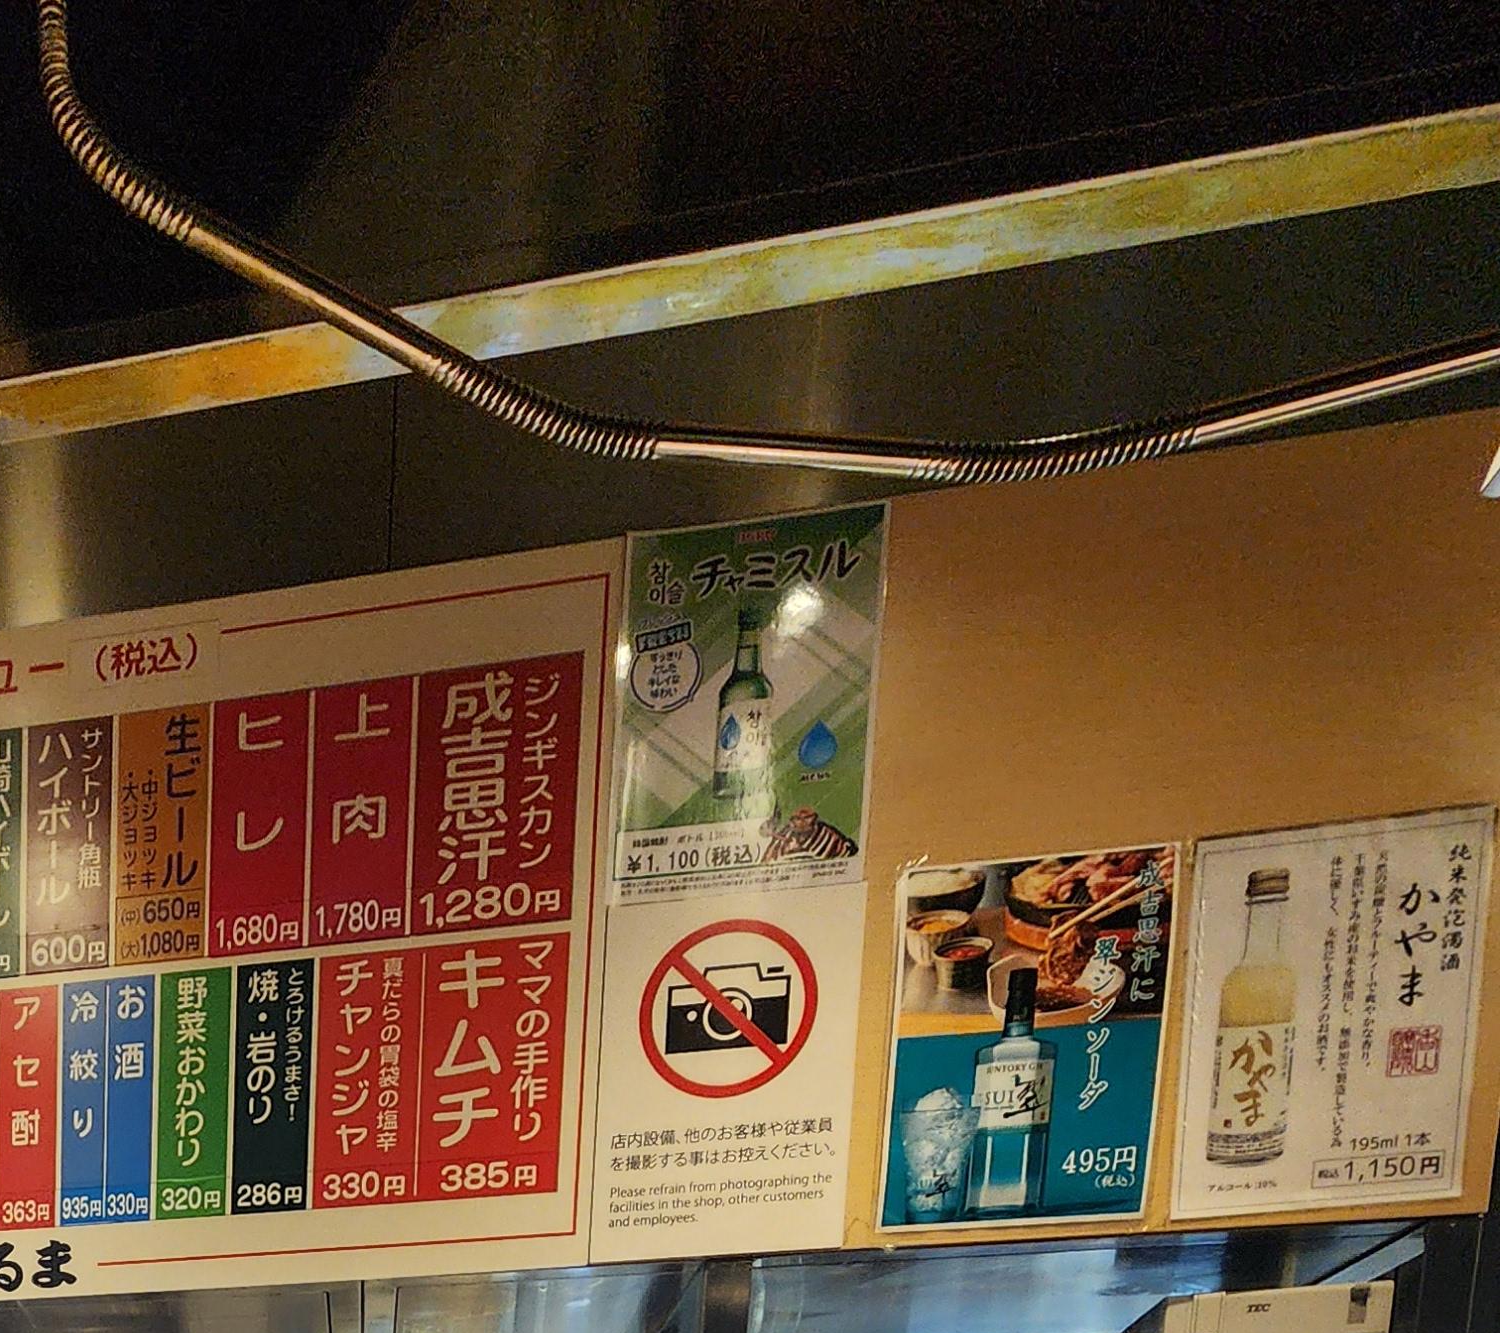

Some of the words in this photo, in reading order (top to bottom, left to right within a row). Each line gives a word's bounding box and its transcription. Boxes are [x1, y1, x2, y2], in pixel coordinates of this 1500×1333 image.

[692, 540, 861, 597] チャミスル
[95, 632, 198, 682] (税込)
[236, 711, 284, 852] ヒレ
[331, 693, 390, 845] 上肉
[438, 671, 514, 885] 成吉思汗
[519, 672, 560, 869] ジンギスカン
[36, 733, 73, 906] ハイボール
[77, 726, 103, 890] サントリー角瓶
[162, 713, 201, 888] 生ビール
[315, 899, 401, 938] 1,780円
[420, 882, 561, 927] 1,280円
[31, 935, 106, 967] 600円
[215, 913, 299, 950] 1,680円
[1129, 861, 1163, 1002] 成吉思汗に
[1393, 882, 1441, 1007] かやま
[113, 984, 146, 1081] お酒
[432, 949, 505, 1148] キムチ
[509, 941, 556, 1142] ママの手作り
[1078, 937, 1122, 1111] 翠ジンソーダ
[10, 996, 41, 1147] アセ酎
[68, 991, 99, 1138] 冷絞り
[175, 976, 208, 1168] 野菜おかわり
[331, 959, 373, 1156] チャンジャ
[375, 957, 405, 1153] 真だらの胃袋の塩辛
[1228, 1029, 1277, 1128] かやま
[984, 1090, 1014, 1106] SUI
[610, 1117, 834, 1150] 店内設備、他のお客様や従業員
[610, 1142, 836, 1172] を撮影する事はお控えください。
[1350, 1134, 1399, 1150] 195ml
[1404, 1131, 1432, 1147] 1本
[440, 1161, 537, 1192] 385円
[1061, 1144, 1138, 1174] 495円
[1343, 1155, 1441, 1183] 1,150円
[62, 1195, 101, 1220] 935円
[107, 1193, 149, 1216] 330円
[161, 1186, 221, 1212] 320円
[236, 1183, 303, 1208] 286円
[322, 1171, 406, 1200] 330円
[609, 1200, 656, 1214] facilities
[657, 1199, 668, 1211] in
[672, 1196, 690, 1210] the
[693, 1194, 725, 1211] shop,
[728, 1191, 760, 1206] other
[762, 1188, 825, 1204] customers
[610, 1184, 646, 1199] Please
[648, 1181, 686, 1197] refrain
[689, 1179, 716, 1195] from
[719, 1173, 810, 1196] photographing
[813, 1172, 832, 1186] the
[1, 1199, 50, 1224] 363円
[608, 1214, 630, 1228] and
[633, 1211, 699, 1228] employees.
